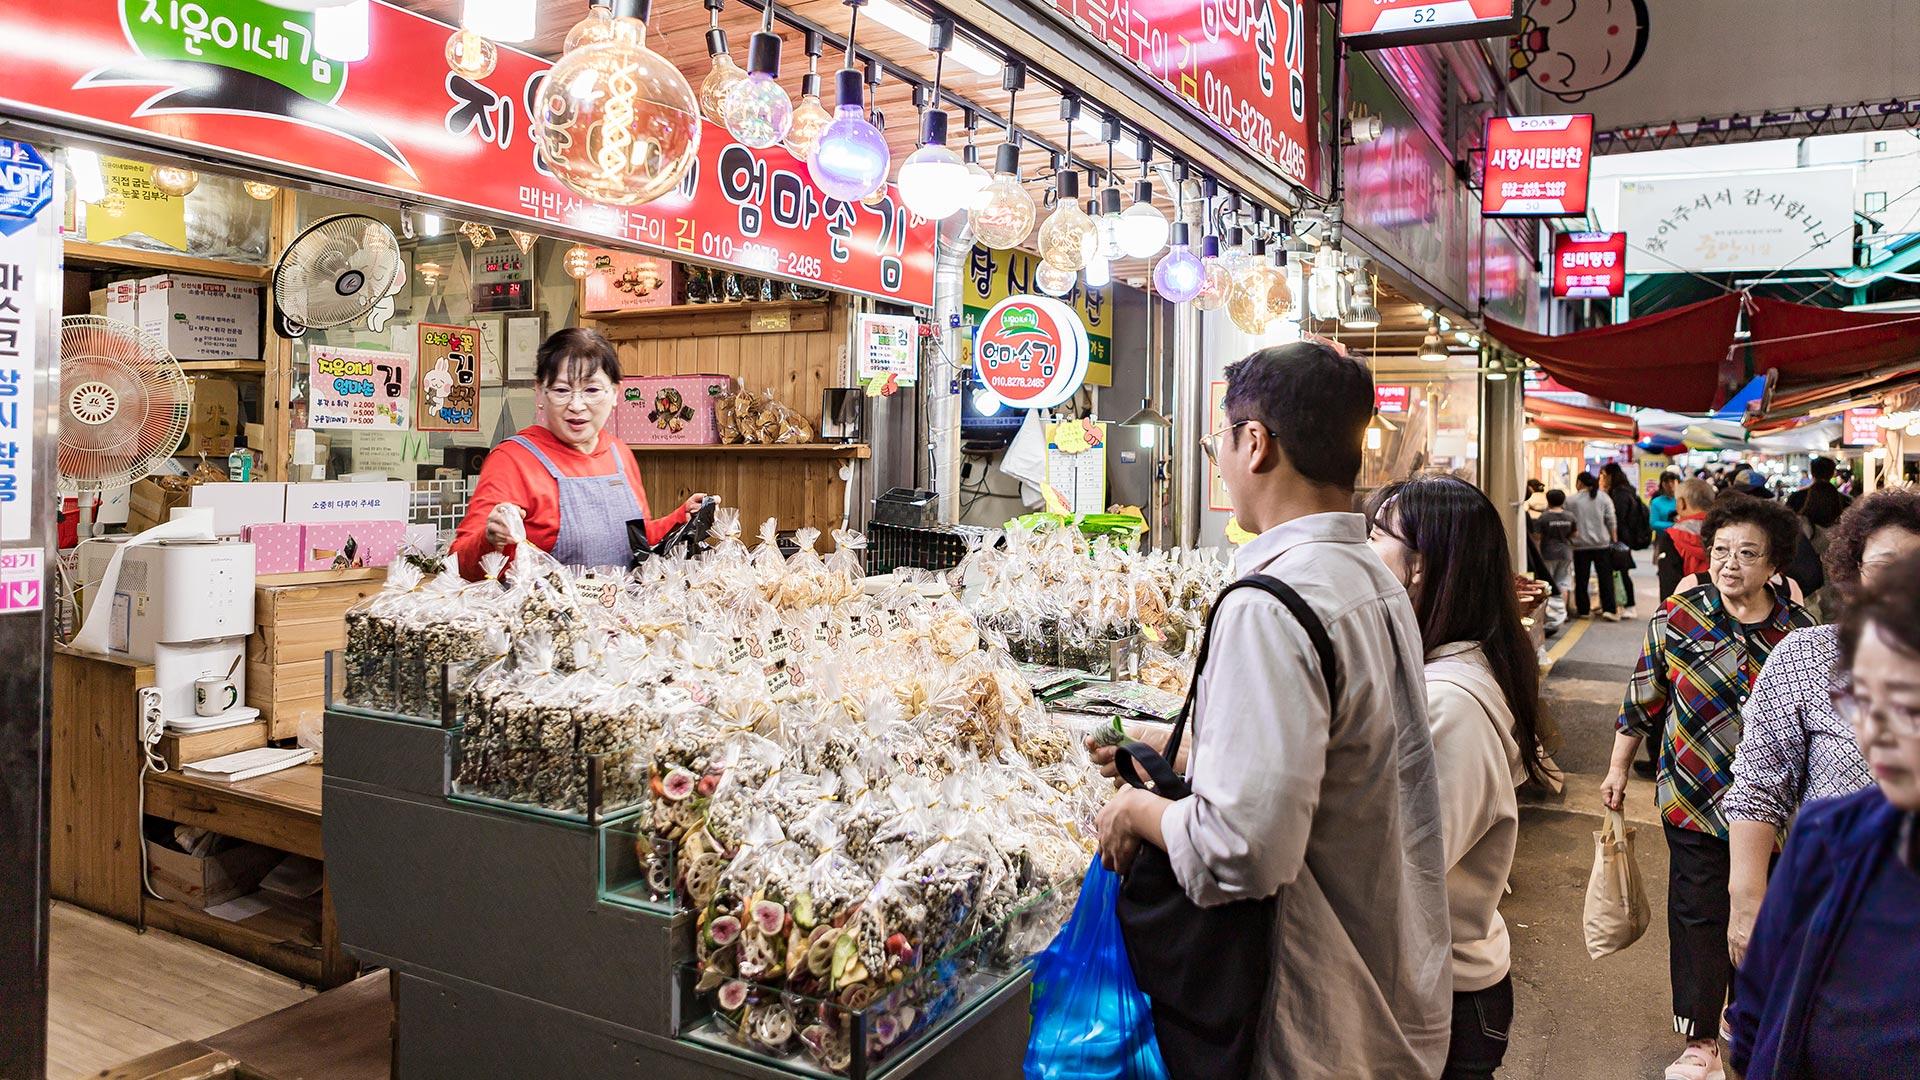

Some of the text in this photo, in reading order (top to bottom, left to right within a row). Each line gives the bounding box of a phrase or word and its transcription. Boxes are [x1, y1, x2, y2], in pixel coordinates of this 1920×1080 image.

[1413, 8, 1436, 24] 52
[1177, 34, 1198, 101] 김
[1203, 70, 1306, 181] 010-8278-2485
[1490, 145, 1583, 170] 시장시민반찬
[112, 176, 129, 186] 직접
[122, 188, 140, 199] 눈꽃
[142, 191, 168, 202] 김부각
[718, 143, 906, 293] 엄마손김
[1743, 187, 1832, 250] 감사합니다
[674, 217, 696, 254] 김
[425, 332, 474, 352] 오늘은 눈꽃
[317, 357, 374, 376] 지운이네
[449, 353, 474, 385] 김
[982, 341, 1056, 376] 엄마손김
[333, 378, 375, 397] 엄마손
[377, 364, 402, 398] 김
[991, 376, 1045, 388] 010.8278.2485
[449, 384, 475, 406] 부각
[312, 499, 381, 509] 소중히 다루어 주세요
